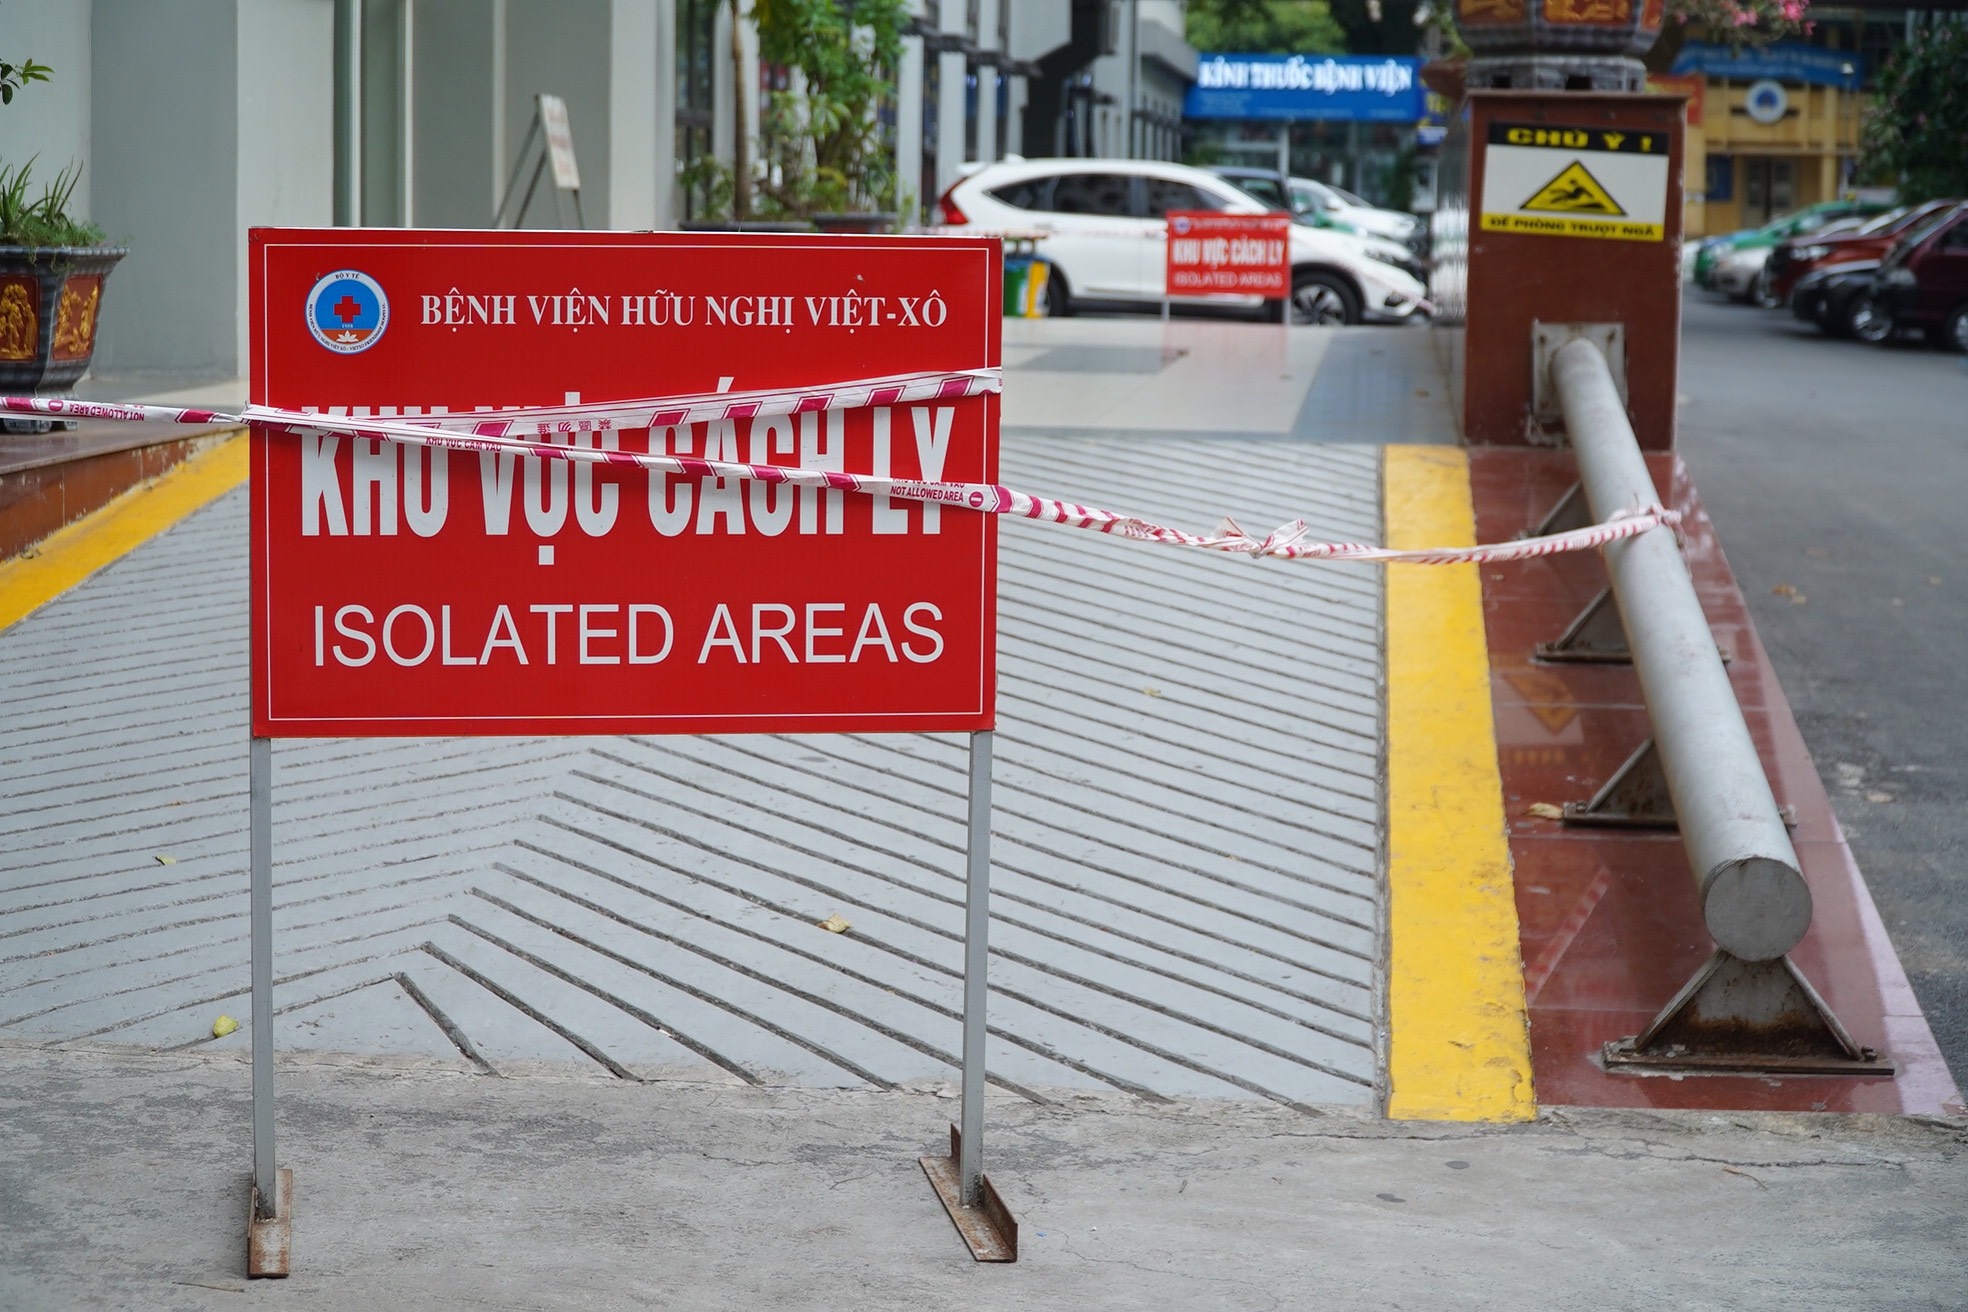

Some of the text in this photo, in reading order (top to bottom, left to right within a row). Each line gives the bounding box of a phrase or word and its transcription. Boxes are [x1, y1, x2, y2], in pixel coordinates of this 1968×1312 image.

[1173, 238, 1200, 266] KHU
[1229, 233, 1266, 266] CÁCH
[1266, 239, 1285, 266] LY
[1174, 270, 1283, 289] ISOLATED AREAS
[420, 287, 947, 334] BỆNH VIỆN HỮU NGHỊ VIỆT-XÔ
[70, 403, 144, 421] NOT ALLOWED AREA
[301, 406, 449, 537] KHU
[648, 376, 845, 537] CÁCH
[872, 406, 956, 535] LY
[890, 486, 964, 502] NOT ALLOWED AREA
[314, 602, 944, 667] ISOLATED AREAS
